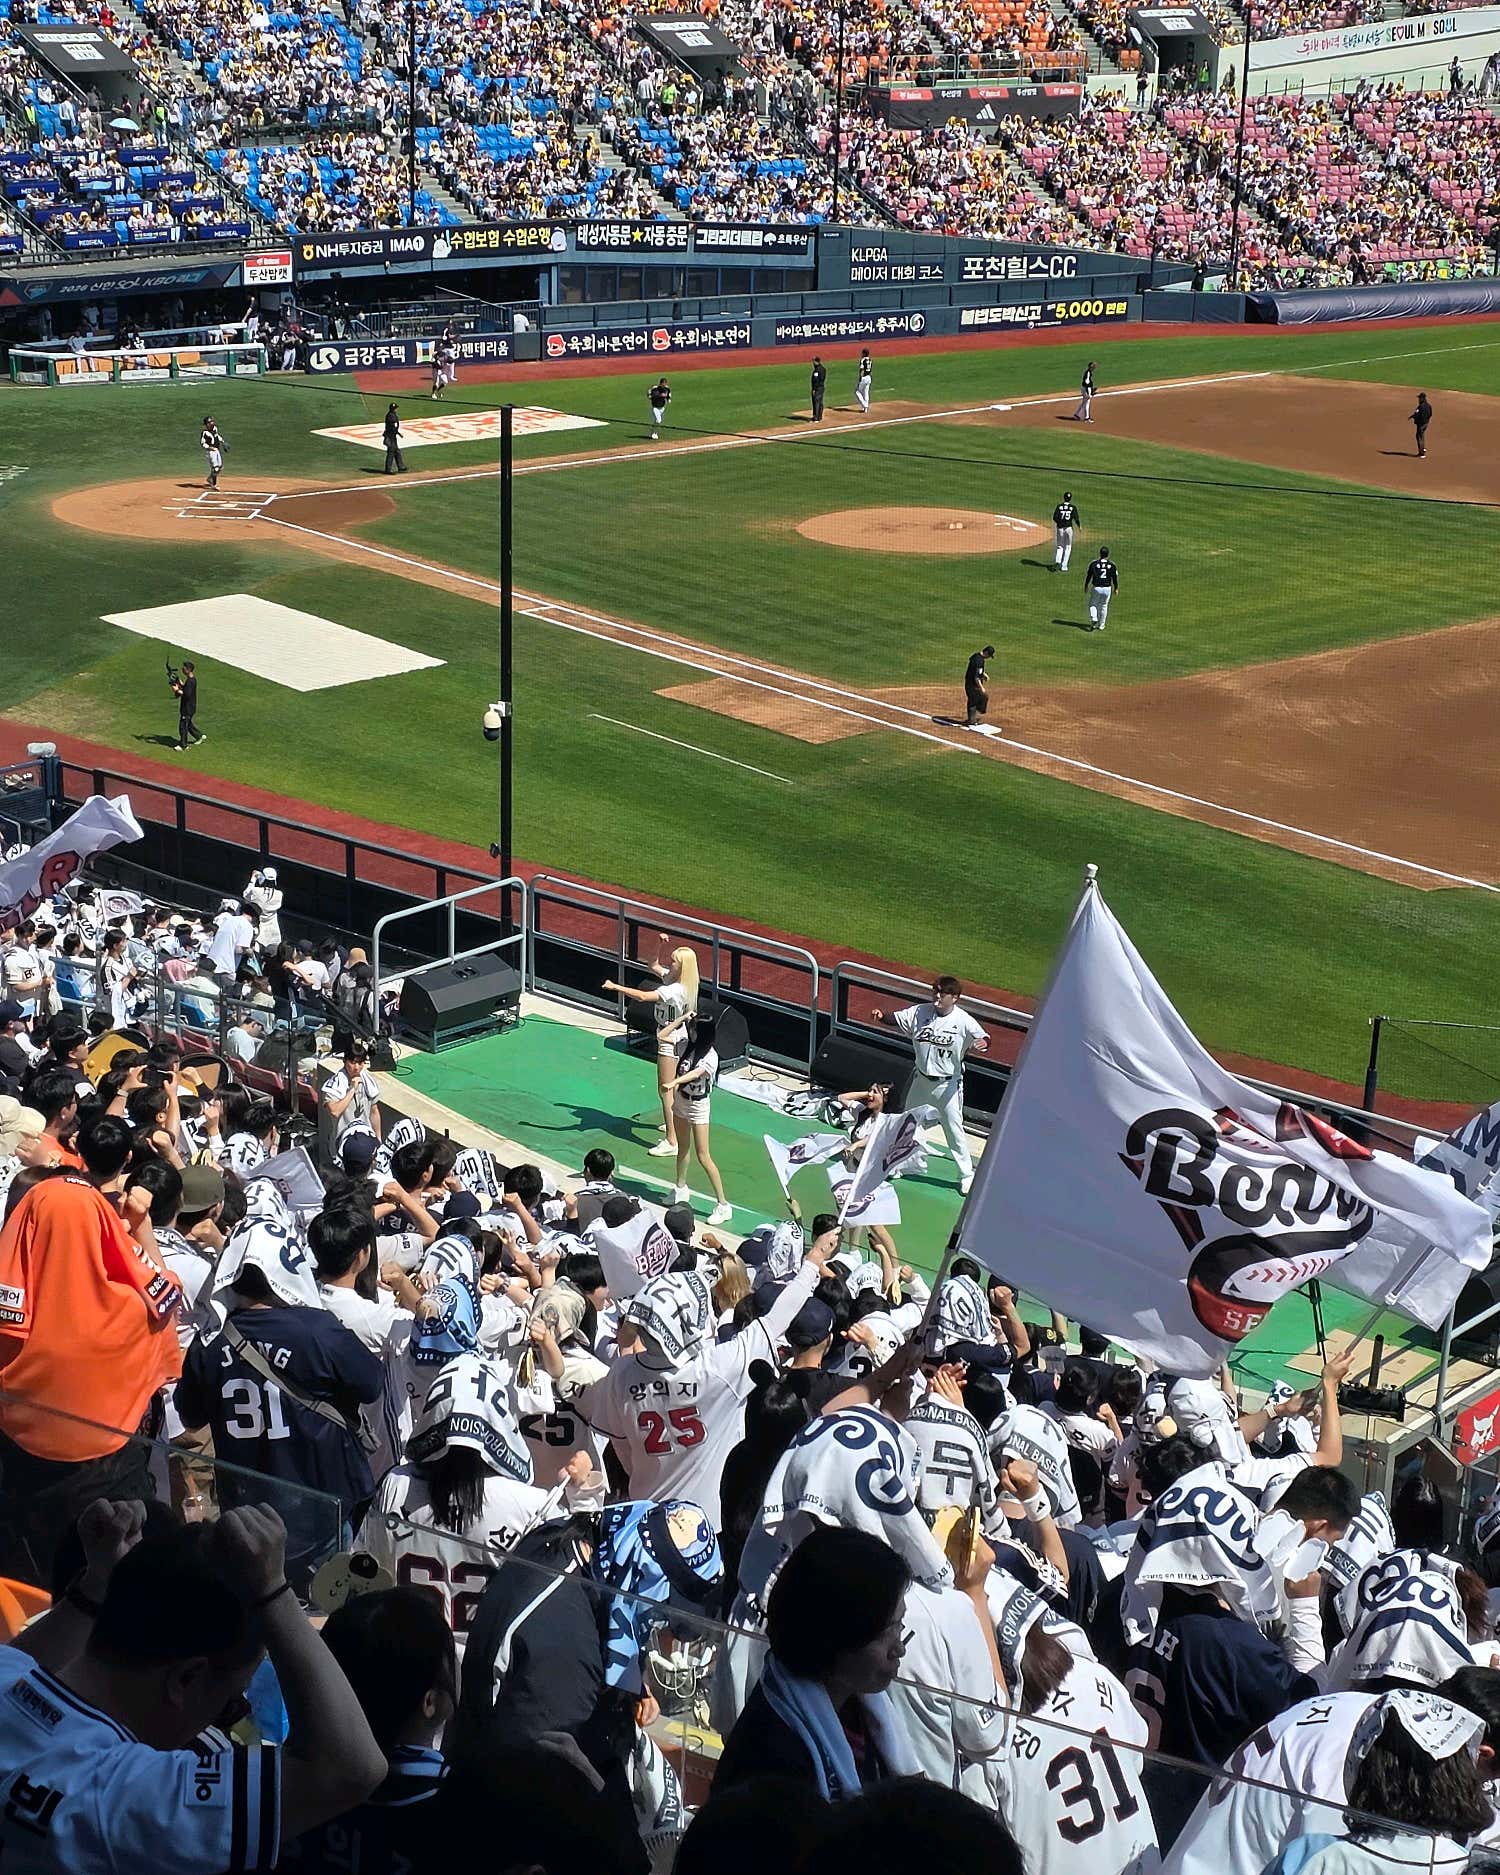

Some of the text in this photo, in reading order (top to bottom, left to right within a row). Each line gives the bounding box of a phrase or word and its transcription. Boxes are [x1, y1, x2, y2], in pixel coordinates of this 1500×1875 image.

[1433, 17, 1457, 35] SOUL
[450, 228, 551, 250] 수협보험 수협은행
[577, 225, 688, 246] 태성자동문 자동중문
[316, 240, 384, 258] NH투자증권
[851, 247, 888, 262] KLPGA
[249, 267, 288, 283] 두산밥캣
[851, 265, 944, 281] 메이저 대회 코스
[962, 255, 1077, 280] 포천힐스CC
[145, 274, 177, 288] KBO
[960, 305, 1042, 326] 불법도박신고
[1055, 300, 1104, 320] 5,000
[876, 315, 909, 334] 충주시
[344, 345, 406, 366] 금강주택
[1100, 568, 1107, 579] 2
[221, 1340, 292, 1369] JNG
[629, 1380, 698, 1401] 양의지
[221, 1378, 291, 1440] 31
[638, 1406, 708, 1457] 25
[1045, 1726, 1140, 1845] 31
